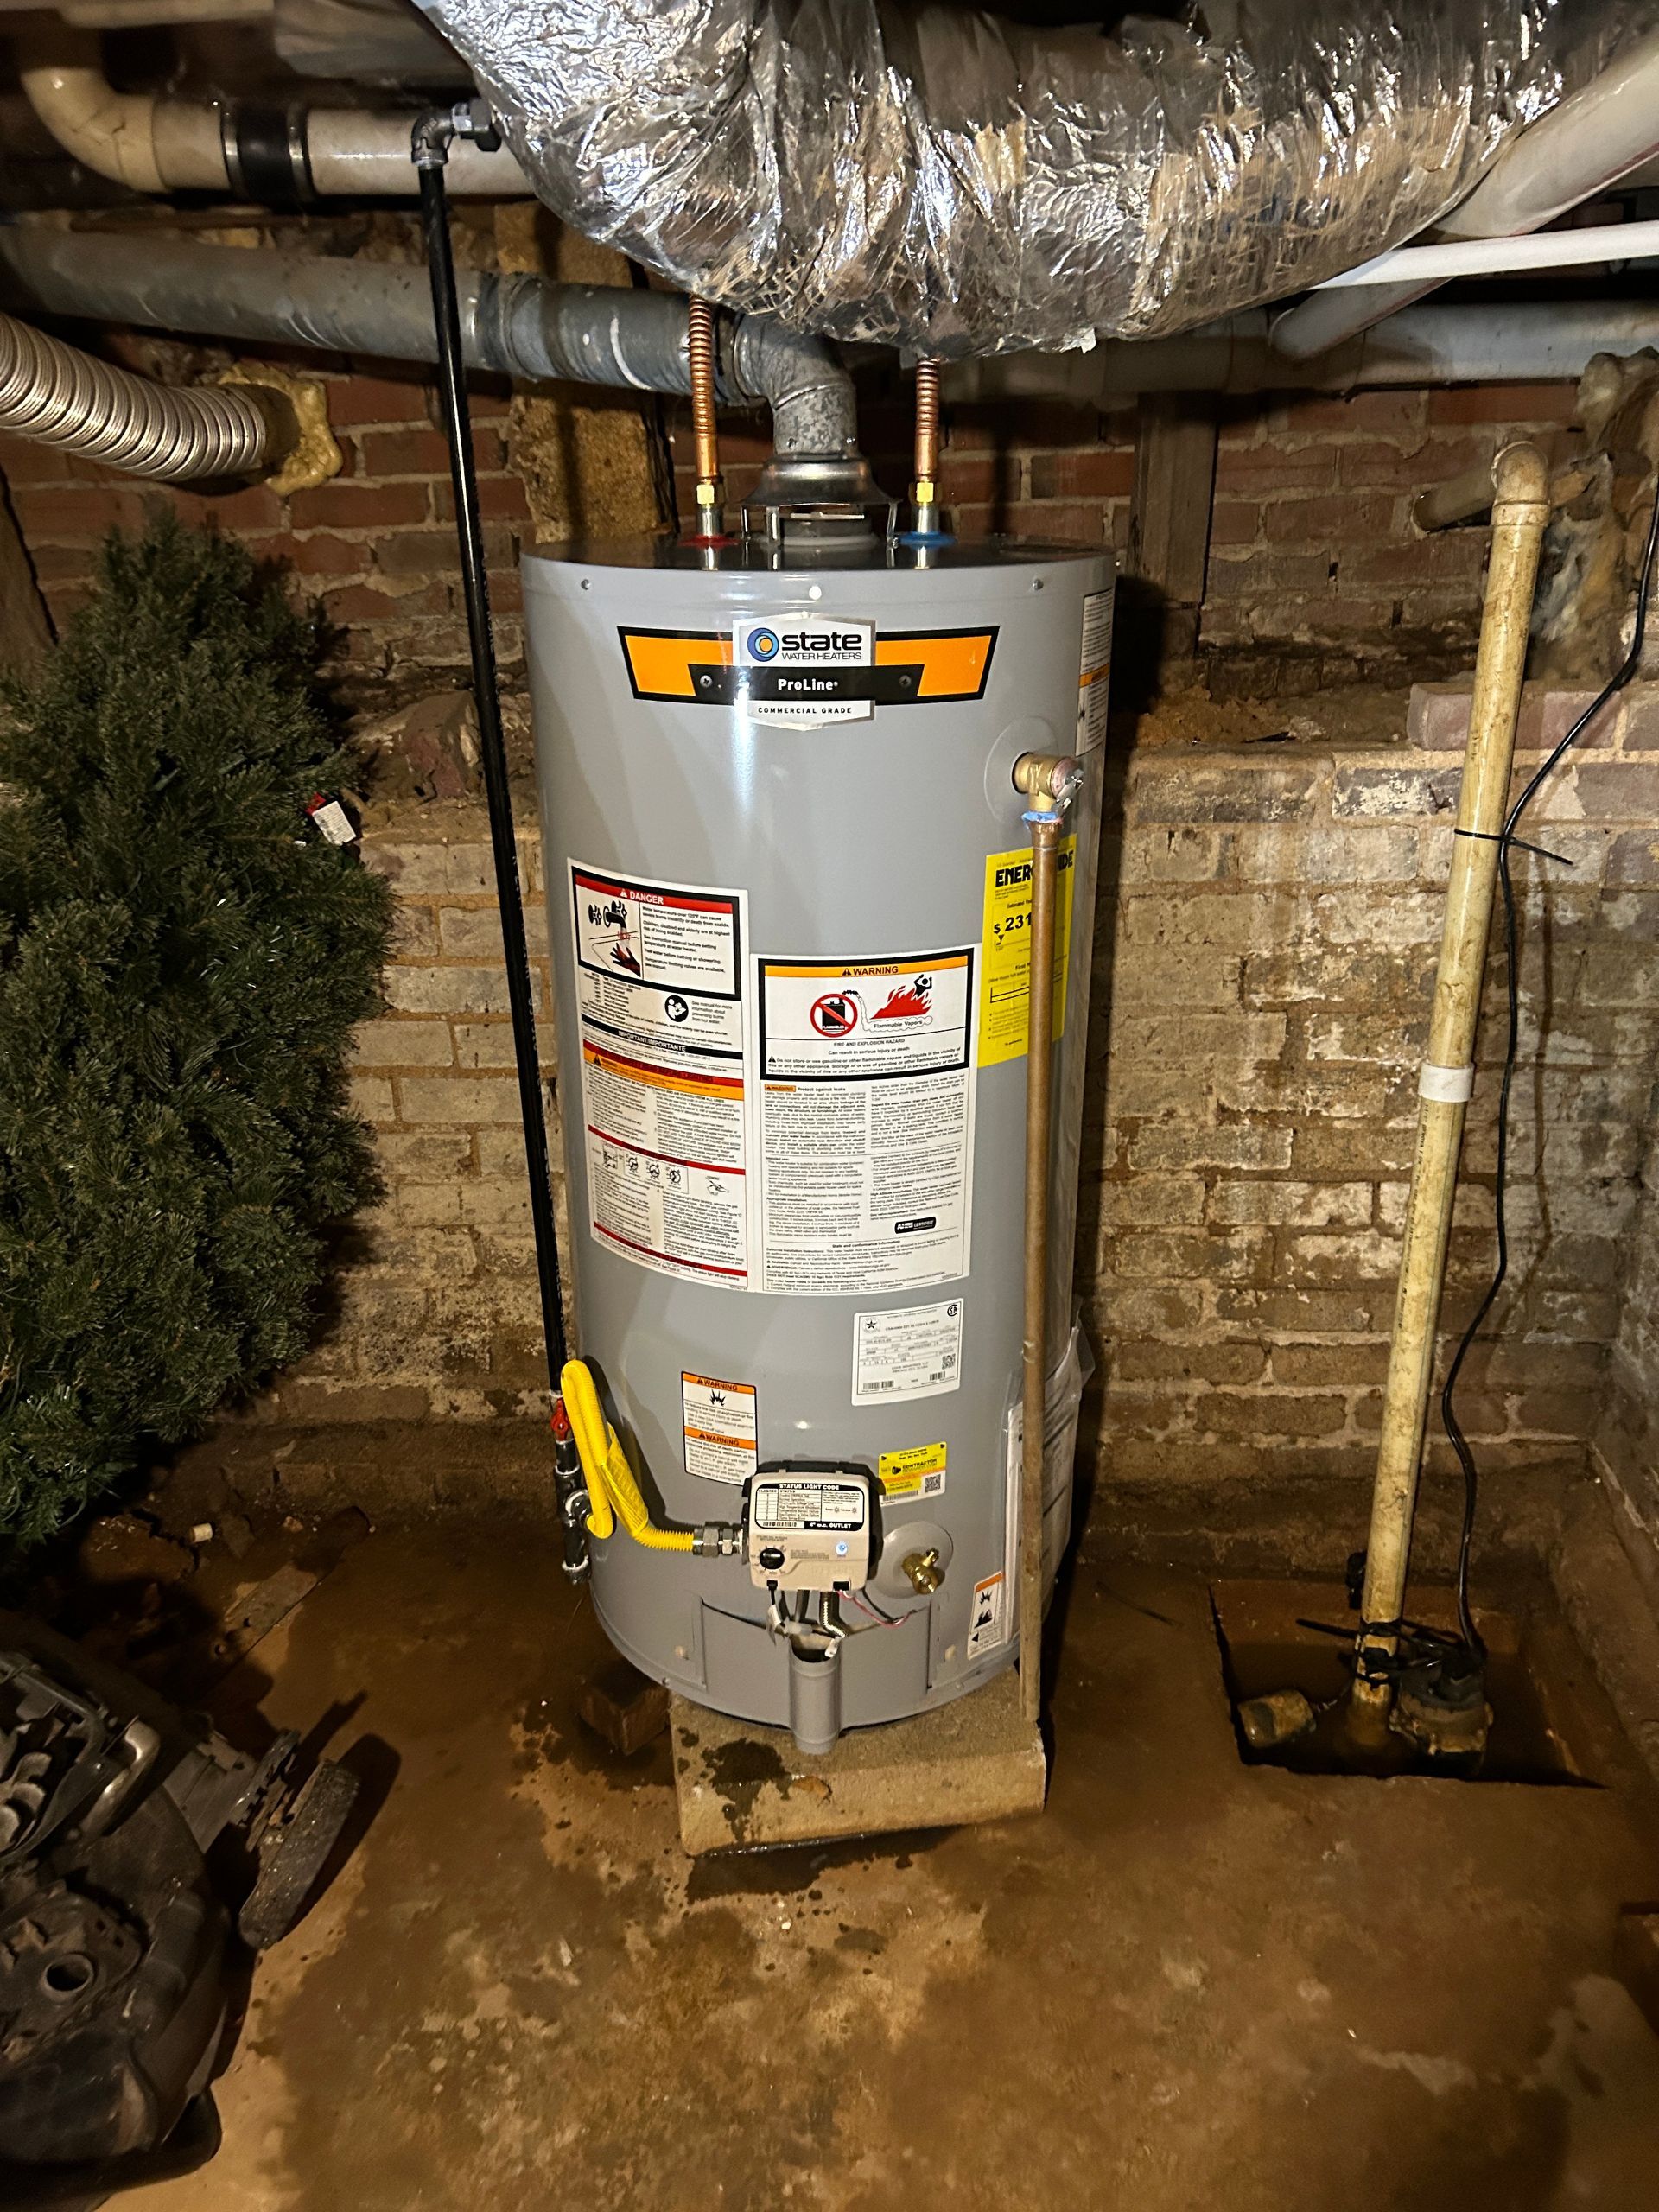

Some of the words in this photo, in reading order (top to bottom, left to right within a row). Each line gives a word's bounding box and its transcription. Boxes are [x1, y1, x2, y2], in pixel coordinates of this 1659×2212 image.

[782, 632, 862, 651] state
[817, 652, 862, 660] HEATERS
[629, 891, 664, 905] DANGER
[1005, 912, 1032, 931] 231
[853, 966, 899, 976] WARNING
[703, 1381, 738, 1391] WARNING
[705, 1434, 740, 1446] WARNING
